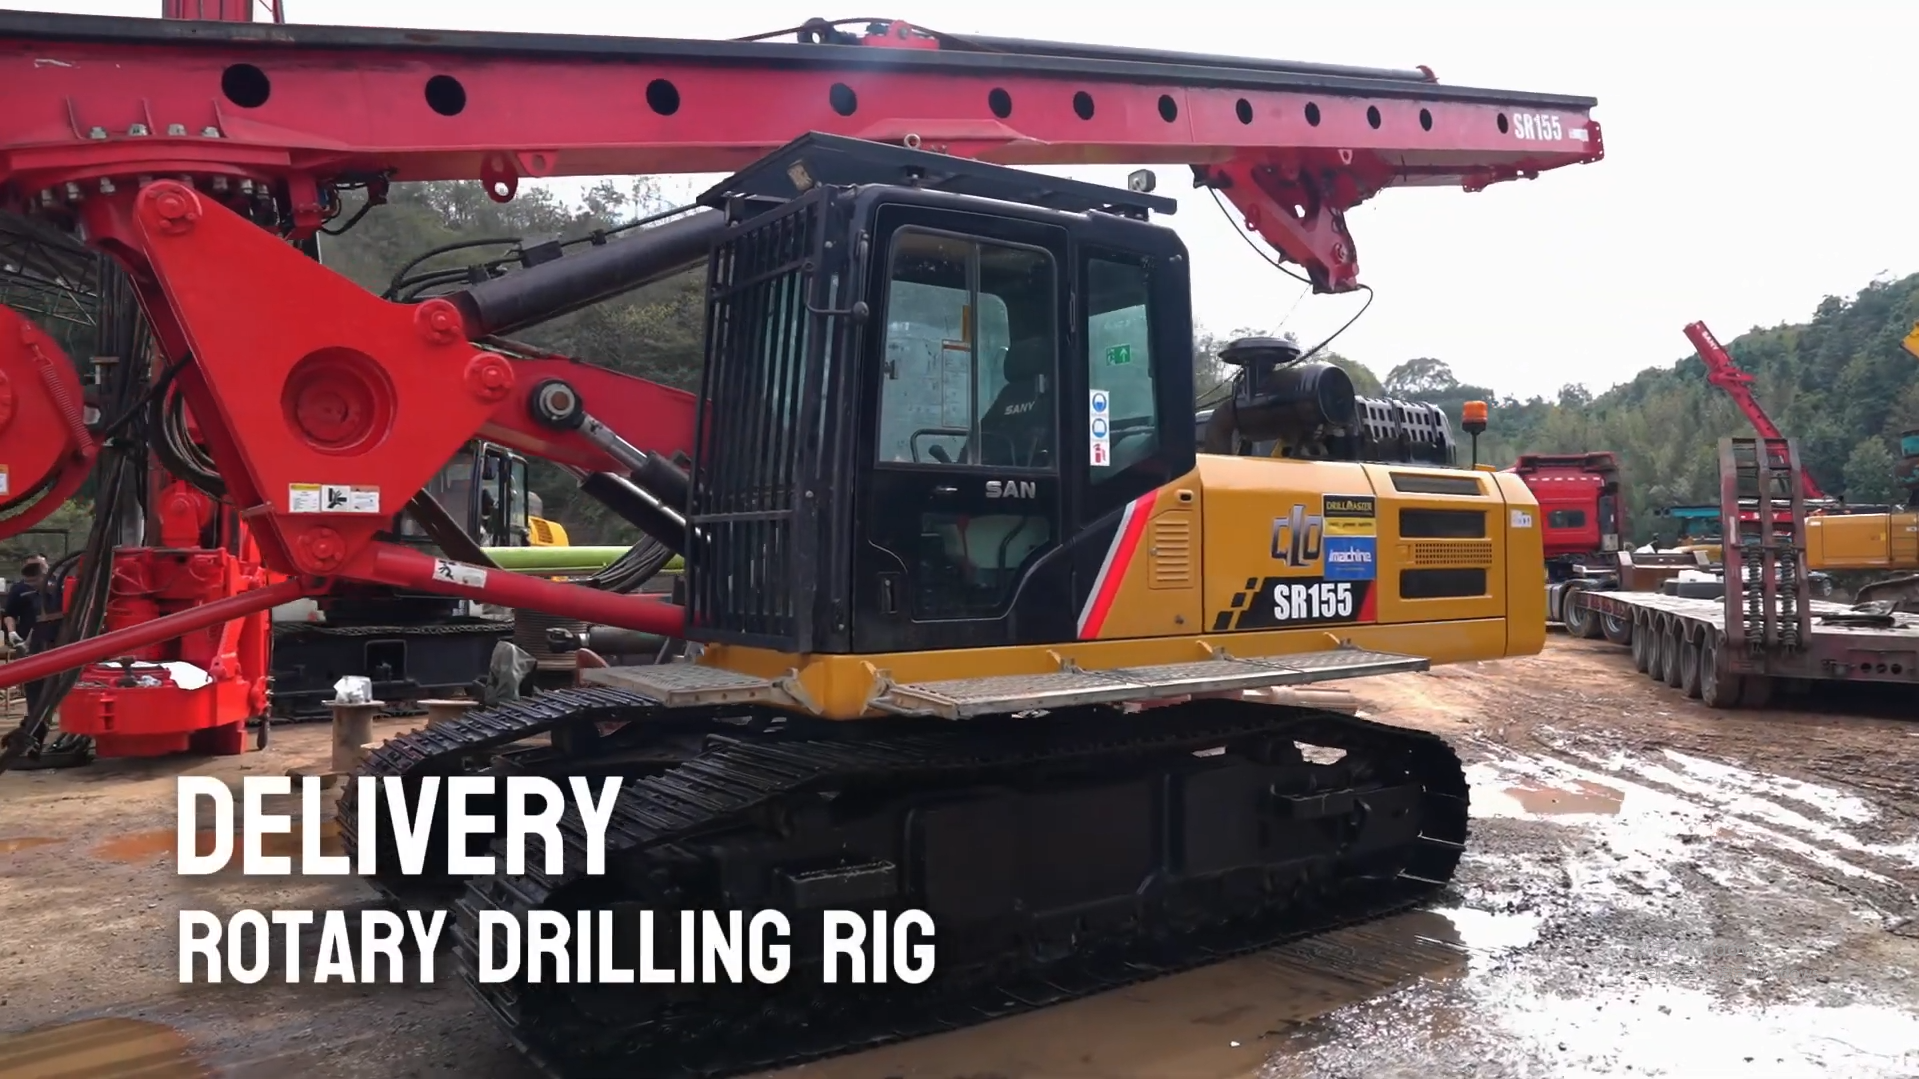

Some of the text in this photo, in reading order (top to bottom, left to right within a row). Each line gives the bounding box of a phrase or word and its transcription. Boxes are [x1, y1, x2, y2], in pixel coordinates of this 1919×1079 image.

[1512, 112, 1563, 142] SR155
[1003, 400, 1036, 416] SANY
[1273, 582, 1353, 620] SR155
